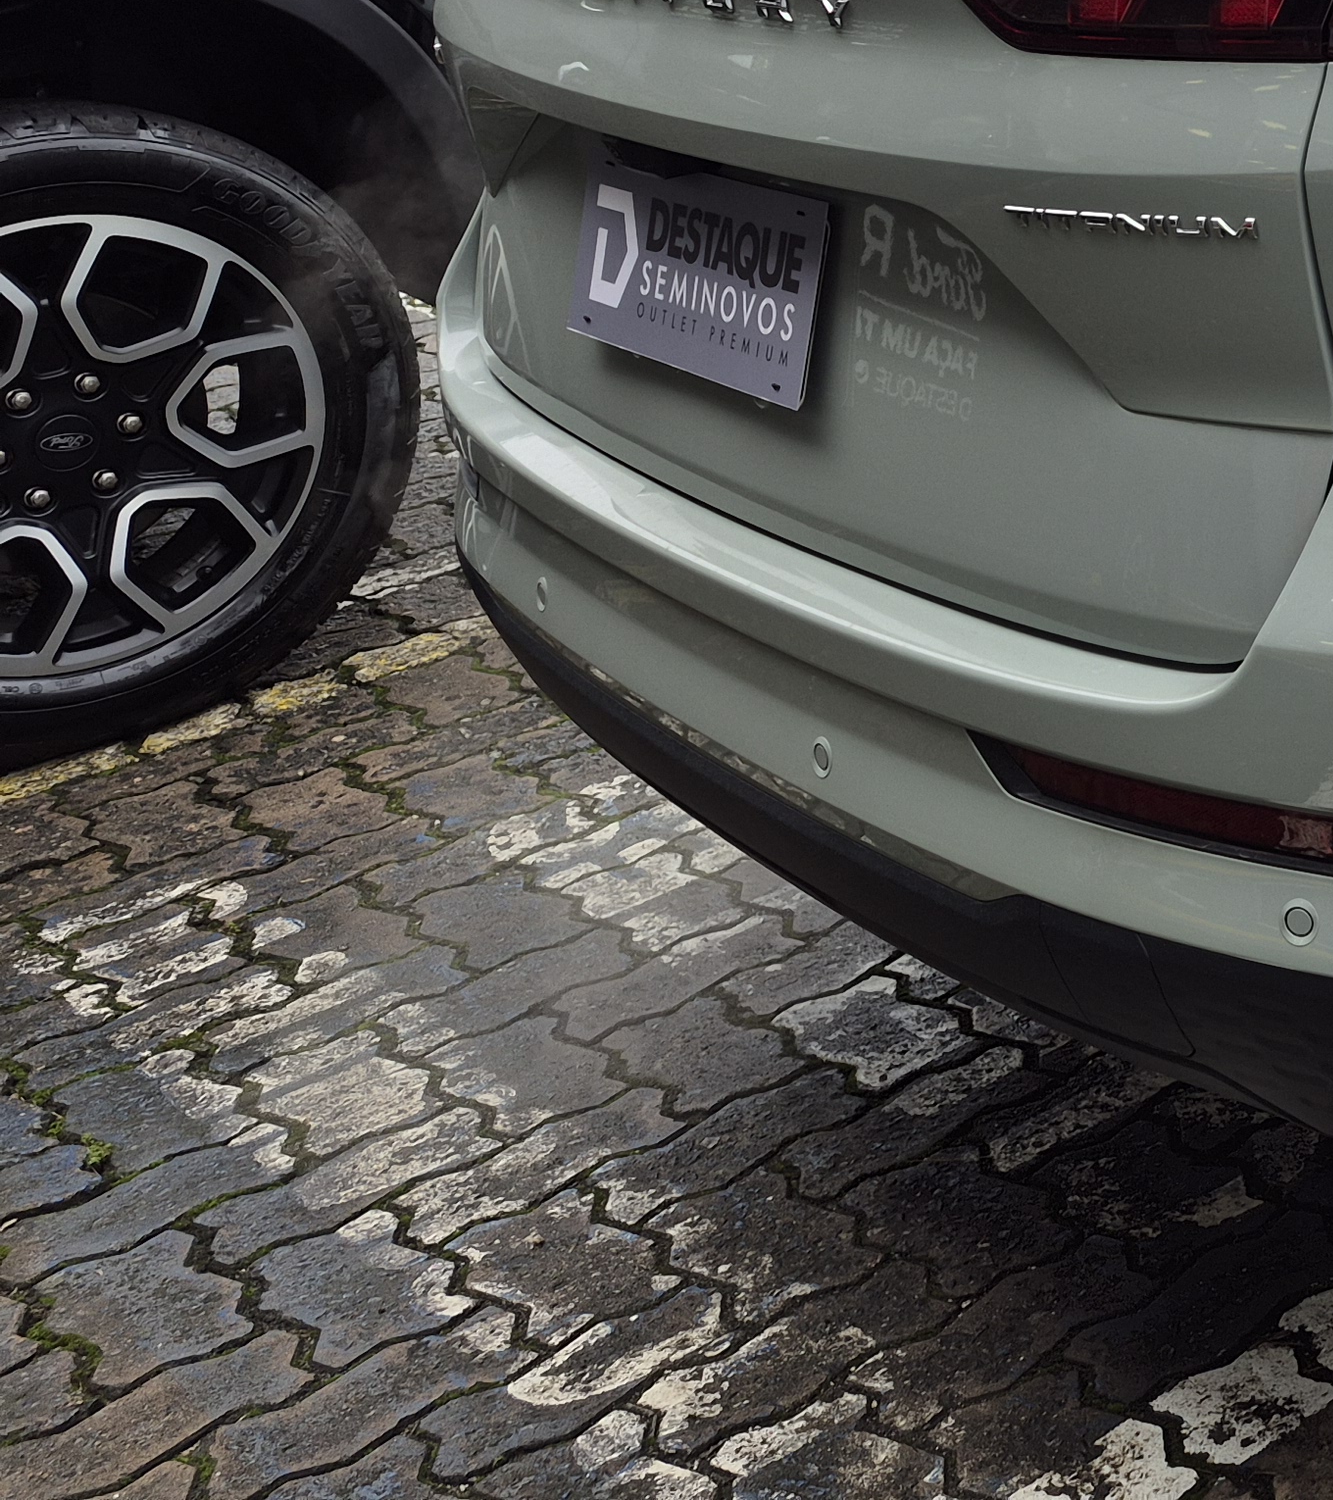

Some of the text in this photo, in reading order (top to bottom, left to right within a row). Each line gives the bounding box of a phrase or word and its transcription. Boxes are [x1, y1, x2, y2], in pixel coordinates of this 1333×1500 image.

[646, 198, 806, 294] DESTAQUE
[1003, 205, 1259, 240] TITANIUM
[636, 302, 790, 368] OUTLET PREMIUM
[639, 260, 797, 342] SEMINOVOS
